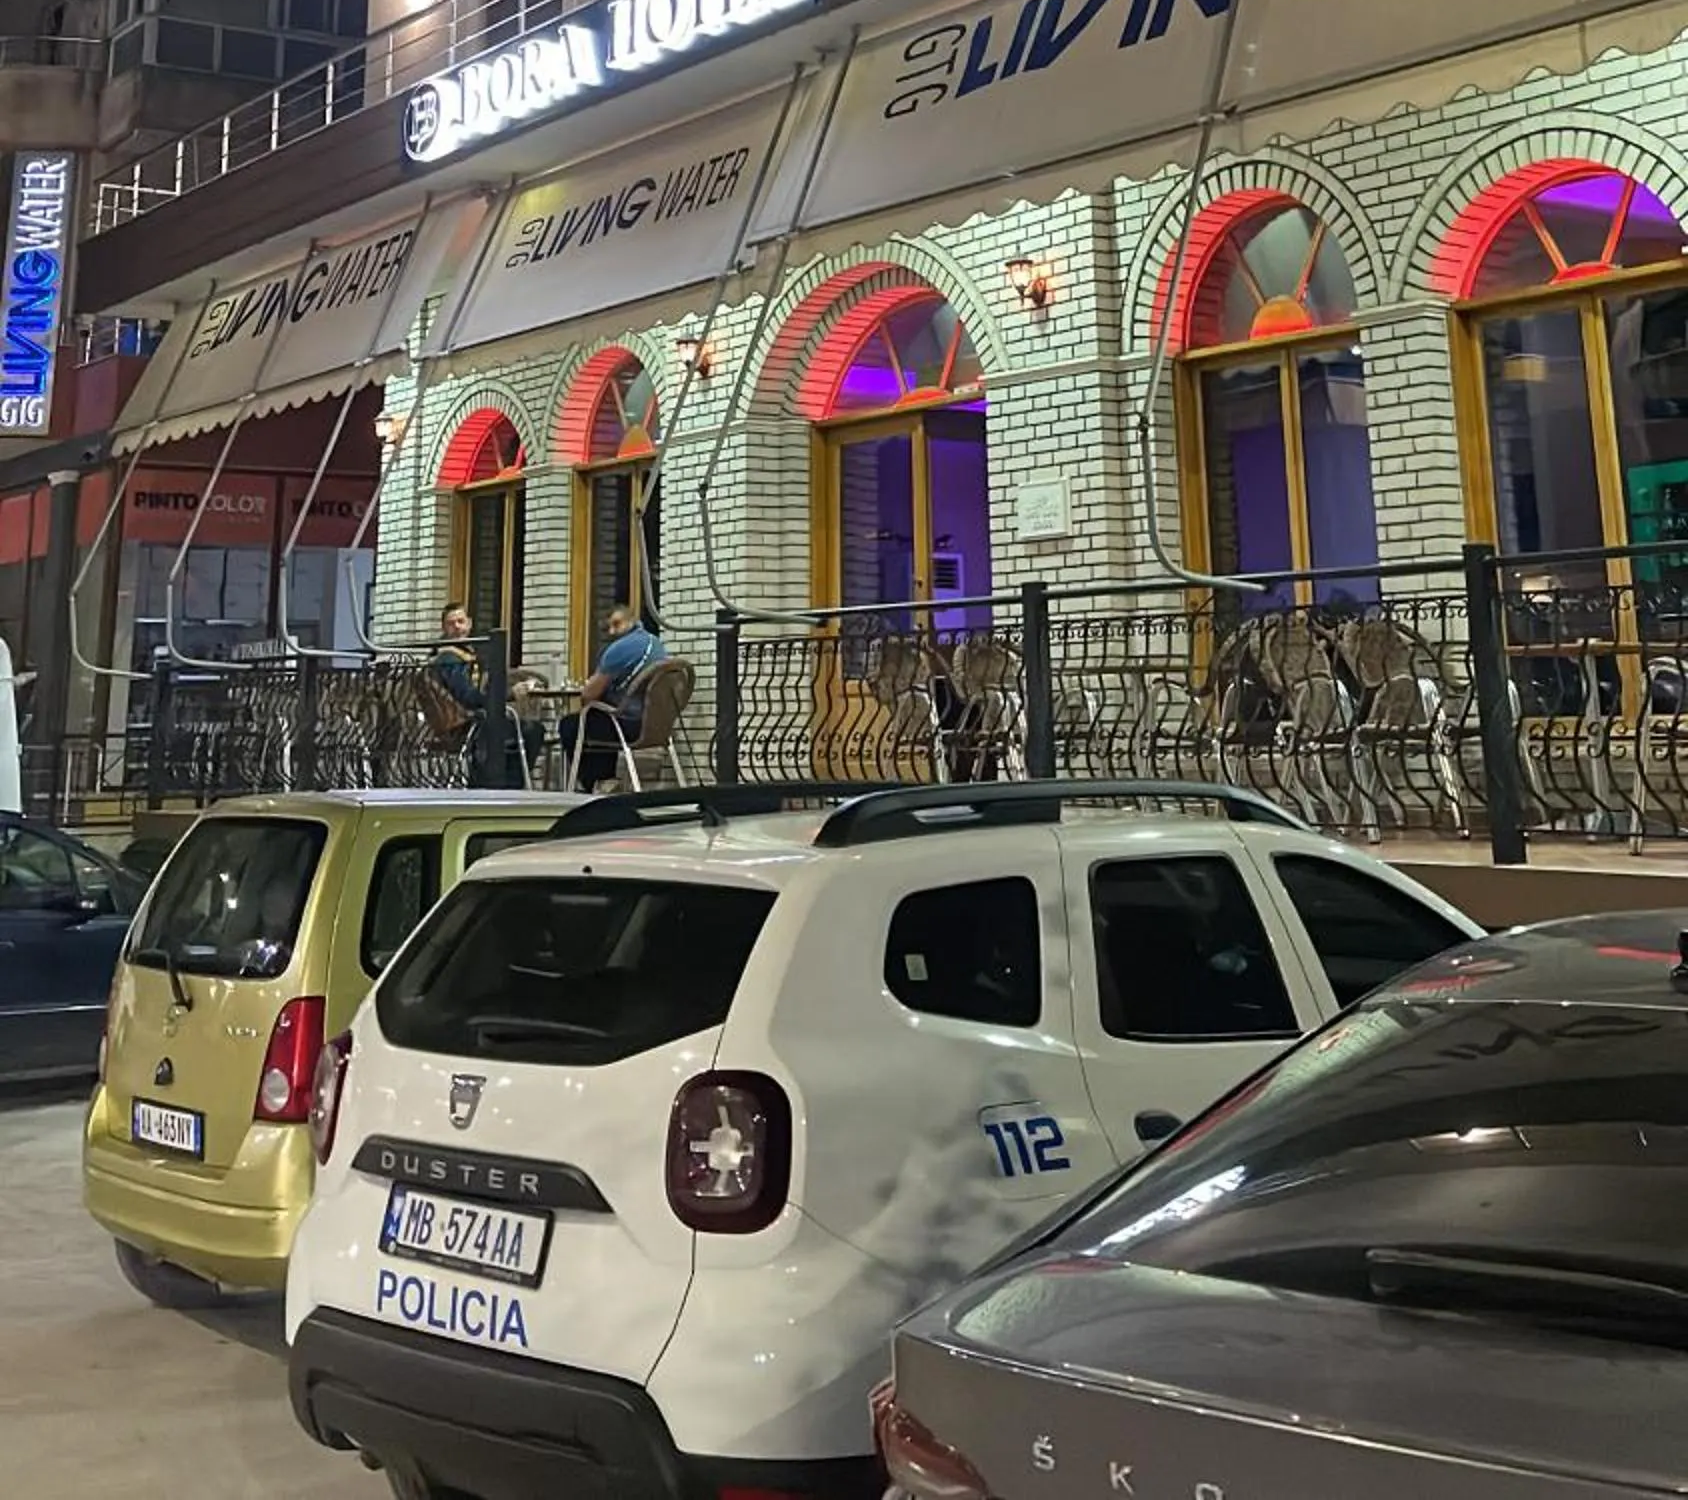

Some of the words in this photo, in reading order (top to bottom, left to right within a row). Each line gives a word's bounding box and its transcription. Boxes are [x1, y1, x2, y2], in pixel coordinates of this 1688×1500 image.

[15, 157, 68, 253] WATER
[530, 177, 657, 264] LIVING
[654, 147, 750, 222] WATER
[0, 250, 59, 396] LIVING
[210, 262, 329, 351] LIVING
[316, 229, 414, 312] WATER
[380, 1151, 540, 1195] DUSTER
[984, 1116, 1071, 1177] 112
[377, 1268, 529, 1349] POLICIA
